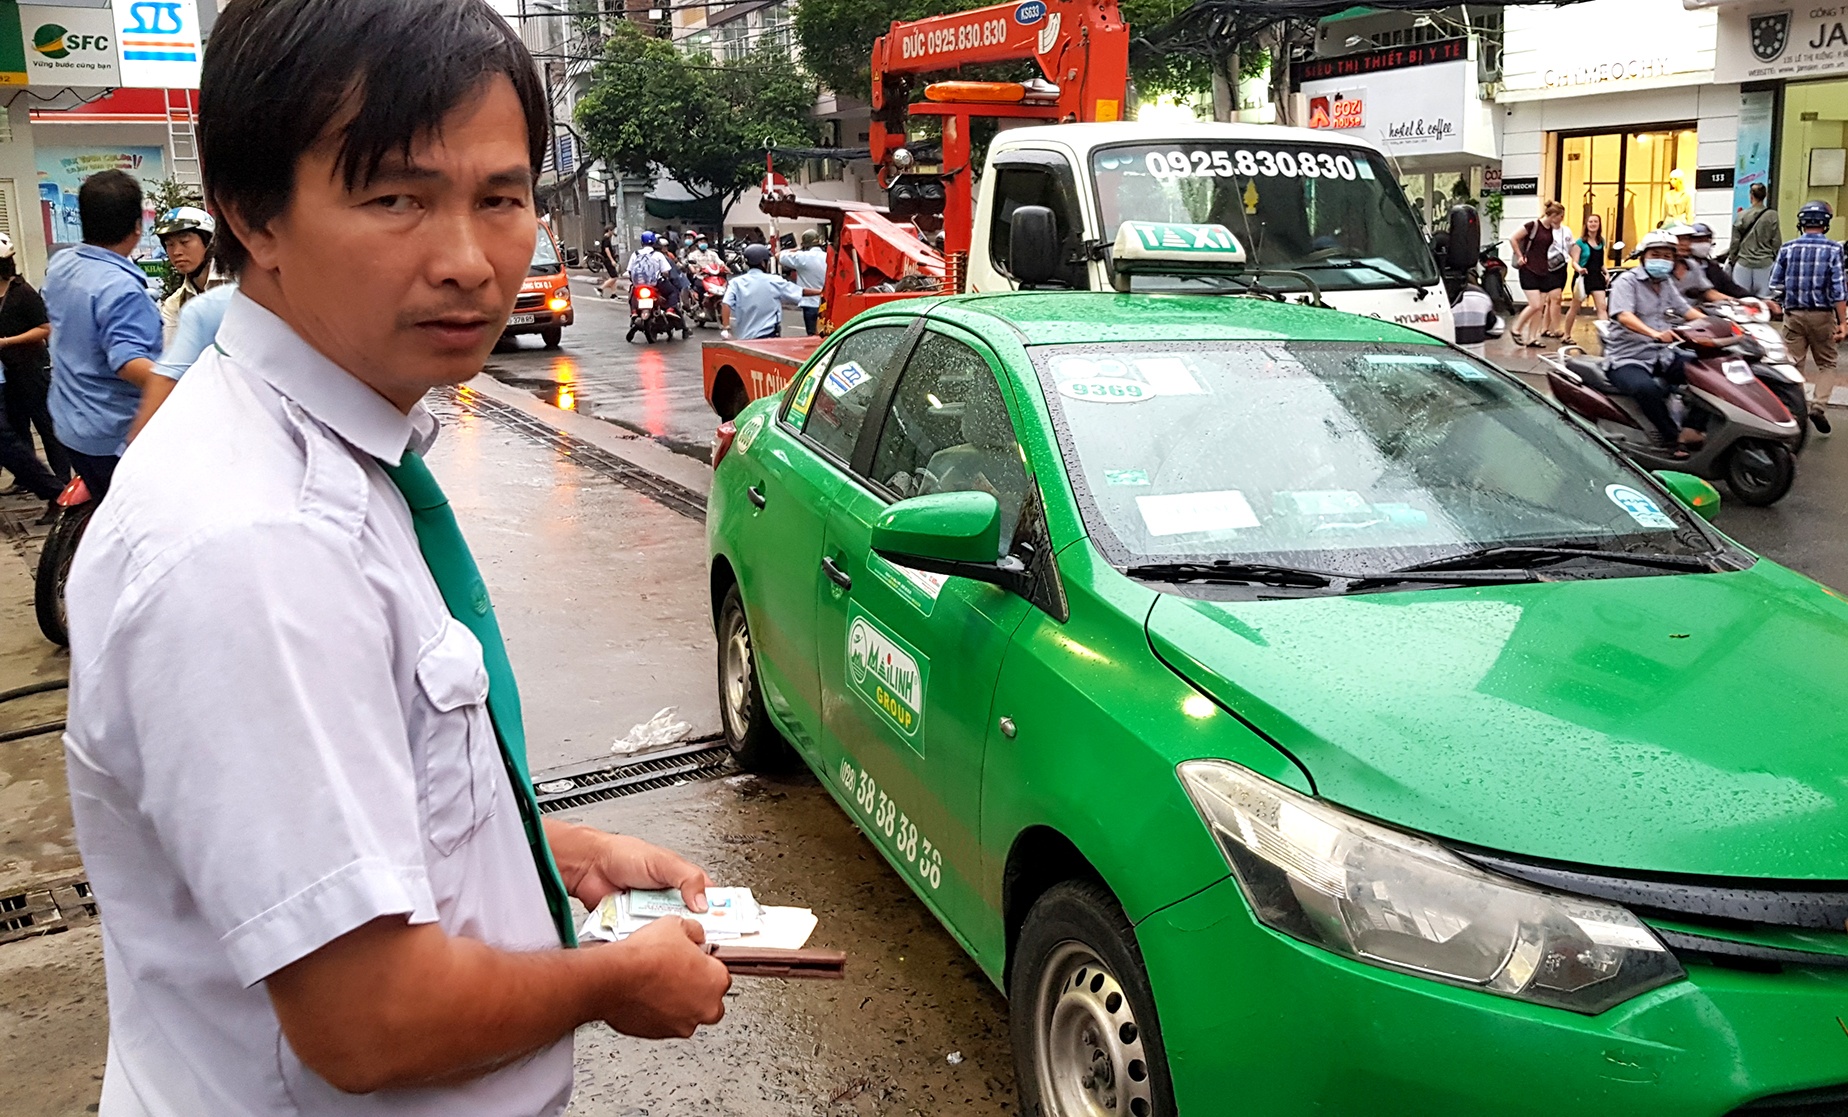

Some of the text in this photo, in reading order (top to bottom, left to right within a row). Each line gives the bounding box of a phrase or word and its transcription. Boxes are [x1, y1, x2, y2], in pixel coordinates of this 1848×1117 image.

[66, 34, 108, 51] SFC
[902, 18, 1006, 59] ĐỨC 0925.830.830
[1338, 60, 1359, 74] THỊ
[1364, 50, 1403, 70] THIẾT
[1408, 49, 1423, 65] BỊ
[1430, 47, 1437, 60] Y
[1333, 100, 1362, 117] COZI
[1389, 118, 1453, 140] hostel & coffee
[1144, 150, 1356, 181] 0925.830.830
[1711, 174, 1725, 182] 133
[1394, 313, 1439, 324] HYUNDAI
[1072, 383, 1142, 397] 9369
[876, 686, 911, 729] GROUP
[856, 768, 876, 814] 38
[876, 790, 896, 838] 38
[897, 812, 918, 862] 38
